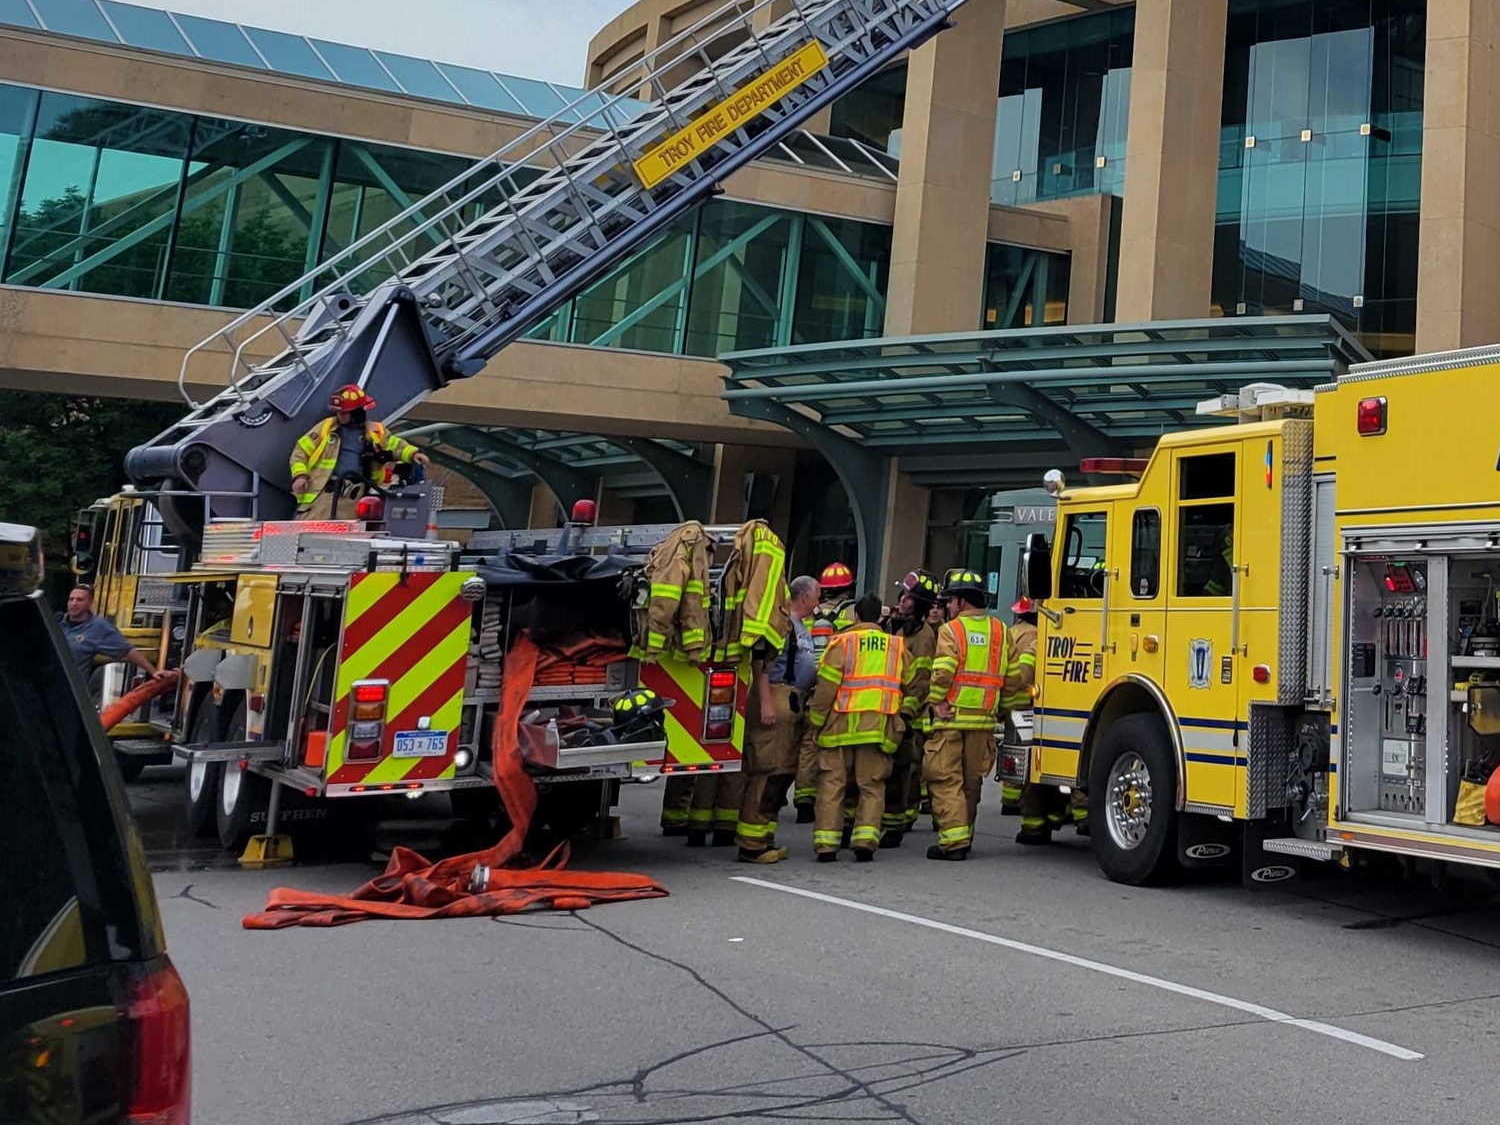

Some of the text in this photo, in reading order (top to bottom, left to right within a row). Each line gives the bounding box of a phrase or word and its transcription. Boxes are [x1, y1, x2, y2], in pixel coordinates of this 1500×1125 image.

[659, 57, 806, 167] TROY FIRE DEPARTMENT
[1018, 509, 1054, 521] VALE
[754, 527, 766, 541] OY
[859, 636, 887, 652] FIRE
[970, 635, 985, 644] 614
[1047, 636, 1076, 658] TROY
[1062, 660, 1091, 683] FIRE
[397, 739, 414, 752] 053
[427, 738, 444, 750] 765
[250, 808, 327, 822] SUPHEN
